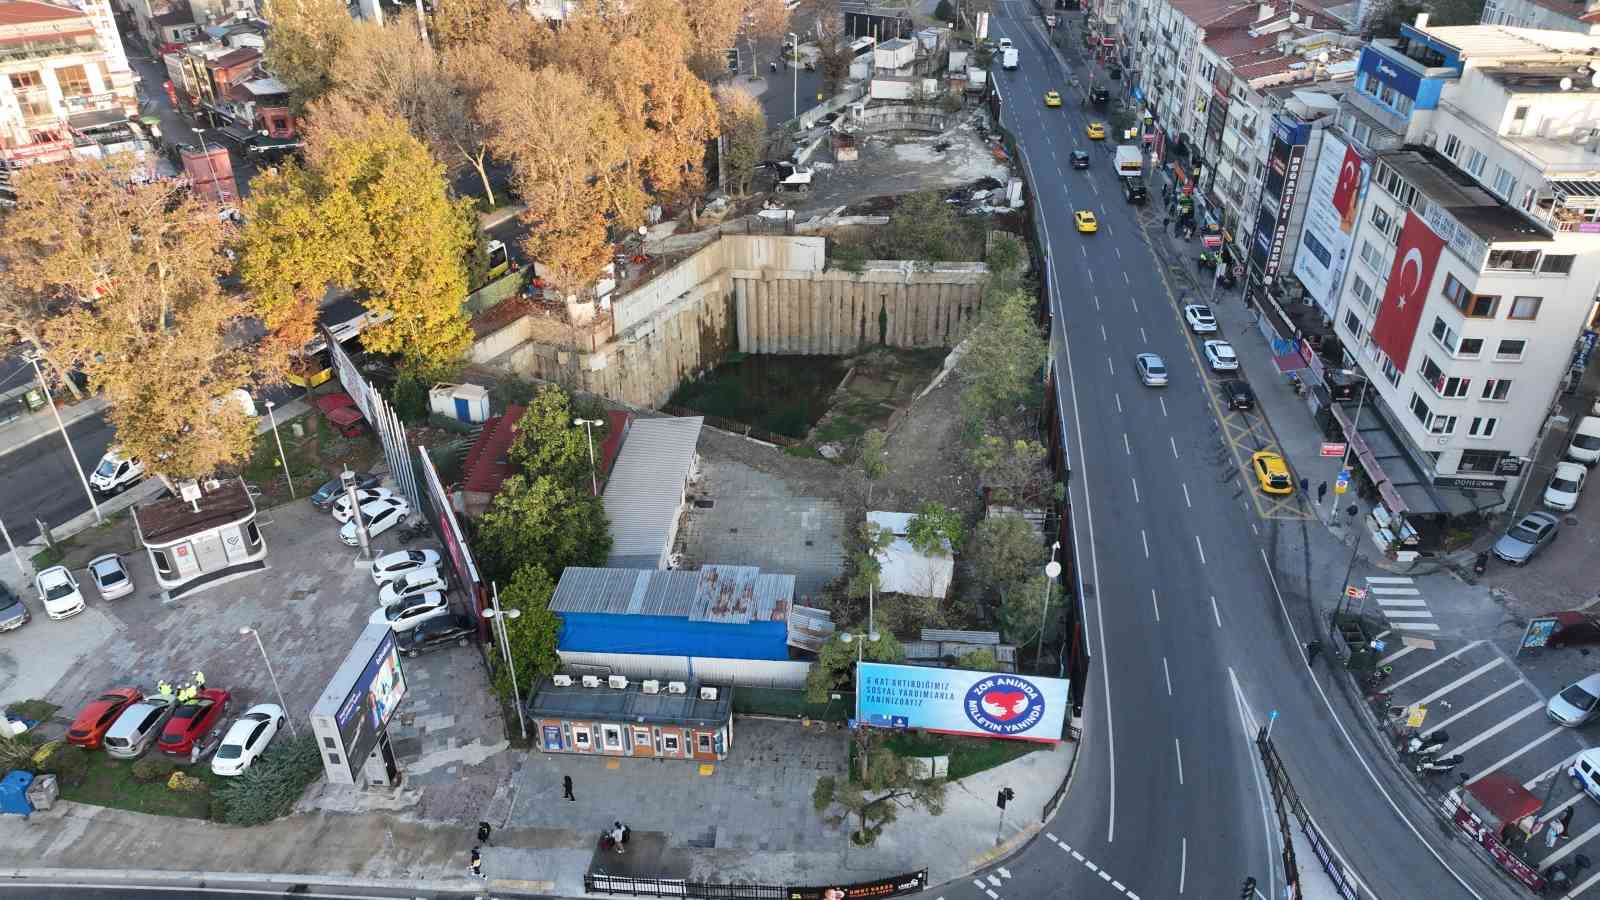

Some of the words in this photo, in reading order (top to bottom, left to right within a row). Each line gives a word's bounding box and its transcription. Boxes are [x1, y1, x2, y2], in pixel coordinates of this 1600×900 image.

[974, 680, 994, 696] ZOR
[996, 678, 1038, 700] ANINDA
[1004, 704, 1042, 732] YANINDA
